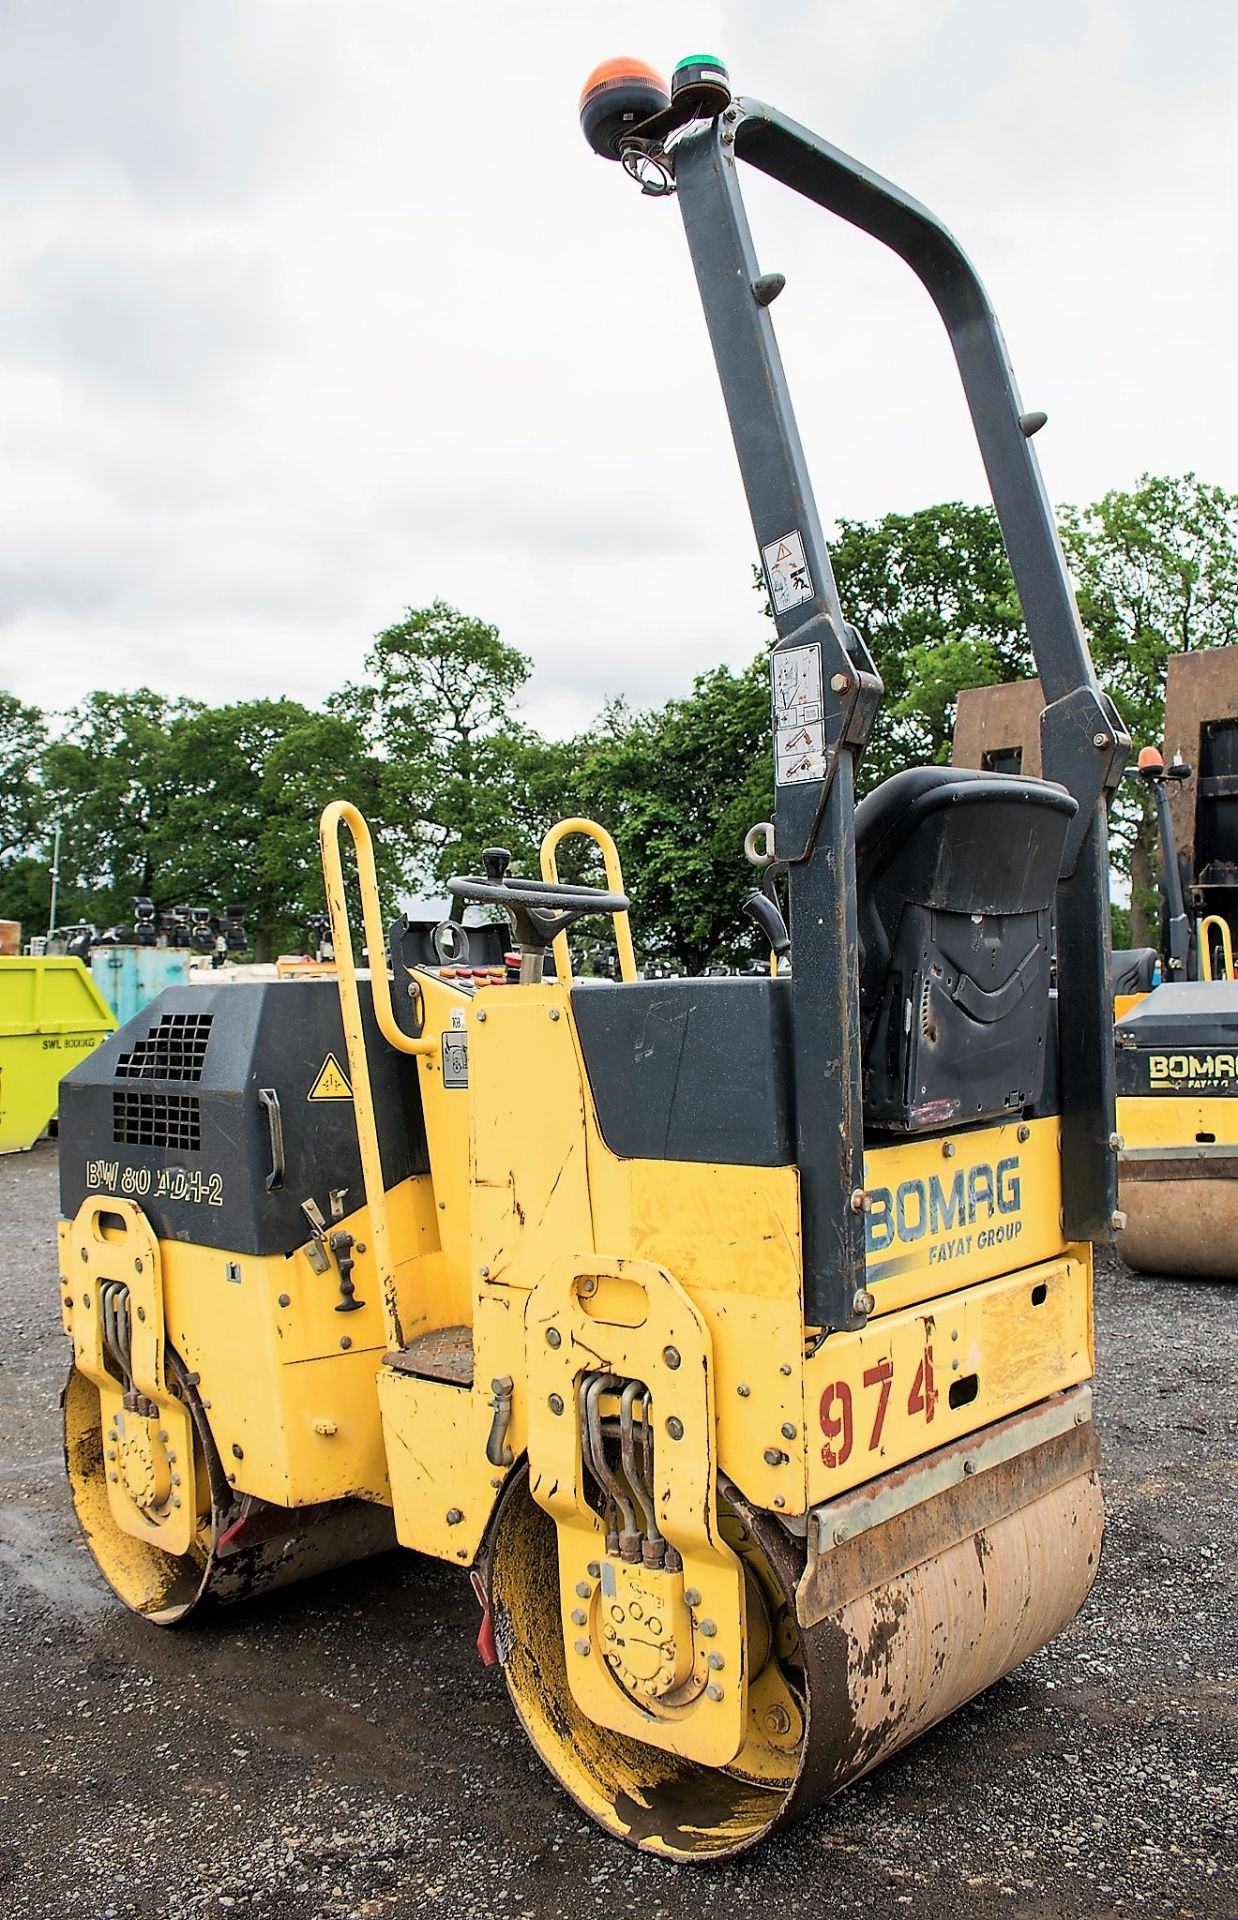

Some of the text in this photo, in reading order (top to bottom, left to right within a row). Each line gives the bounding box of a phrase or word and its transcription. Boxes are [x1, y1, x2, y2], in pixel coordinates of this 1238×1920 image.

[1149, 1054, 1238, 1078] BOMA
[86, 1160, 223, 1206] BW 80 ADH-2
[865, 1155, 1021, 1253] BOMAG
[928, 1221, 1022, 1265] FAYAT GROUP
[820, 1345, 938, 1468] 974
